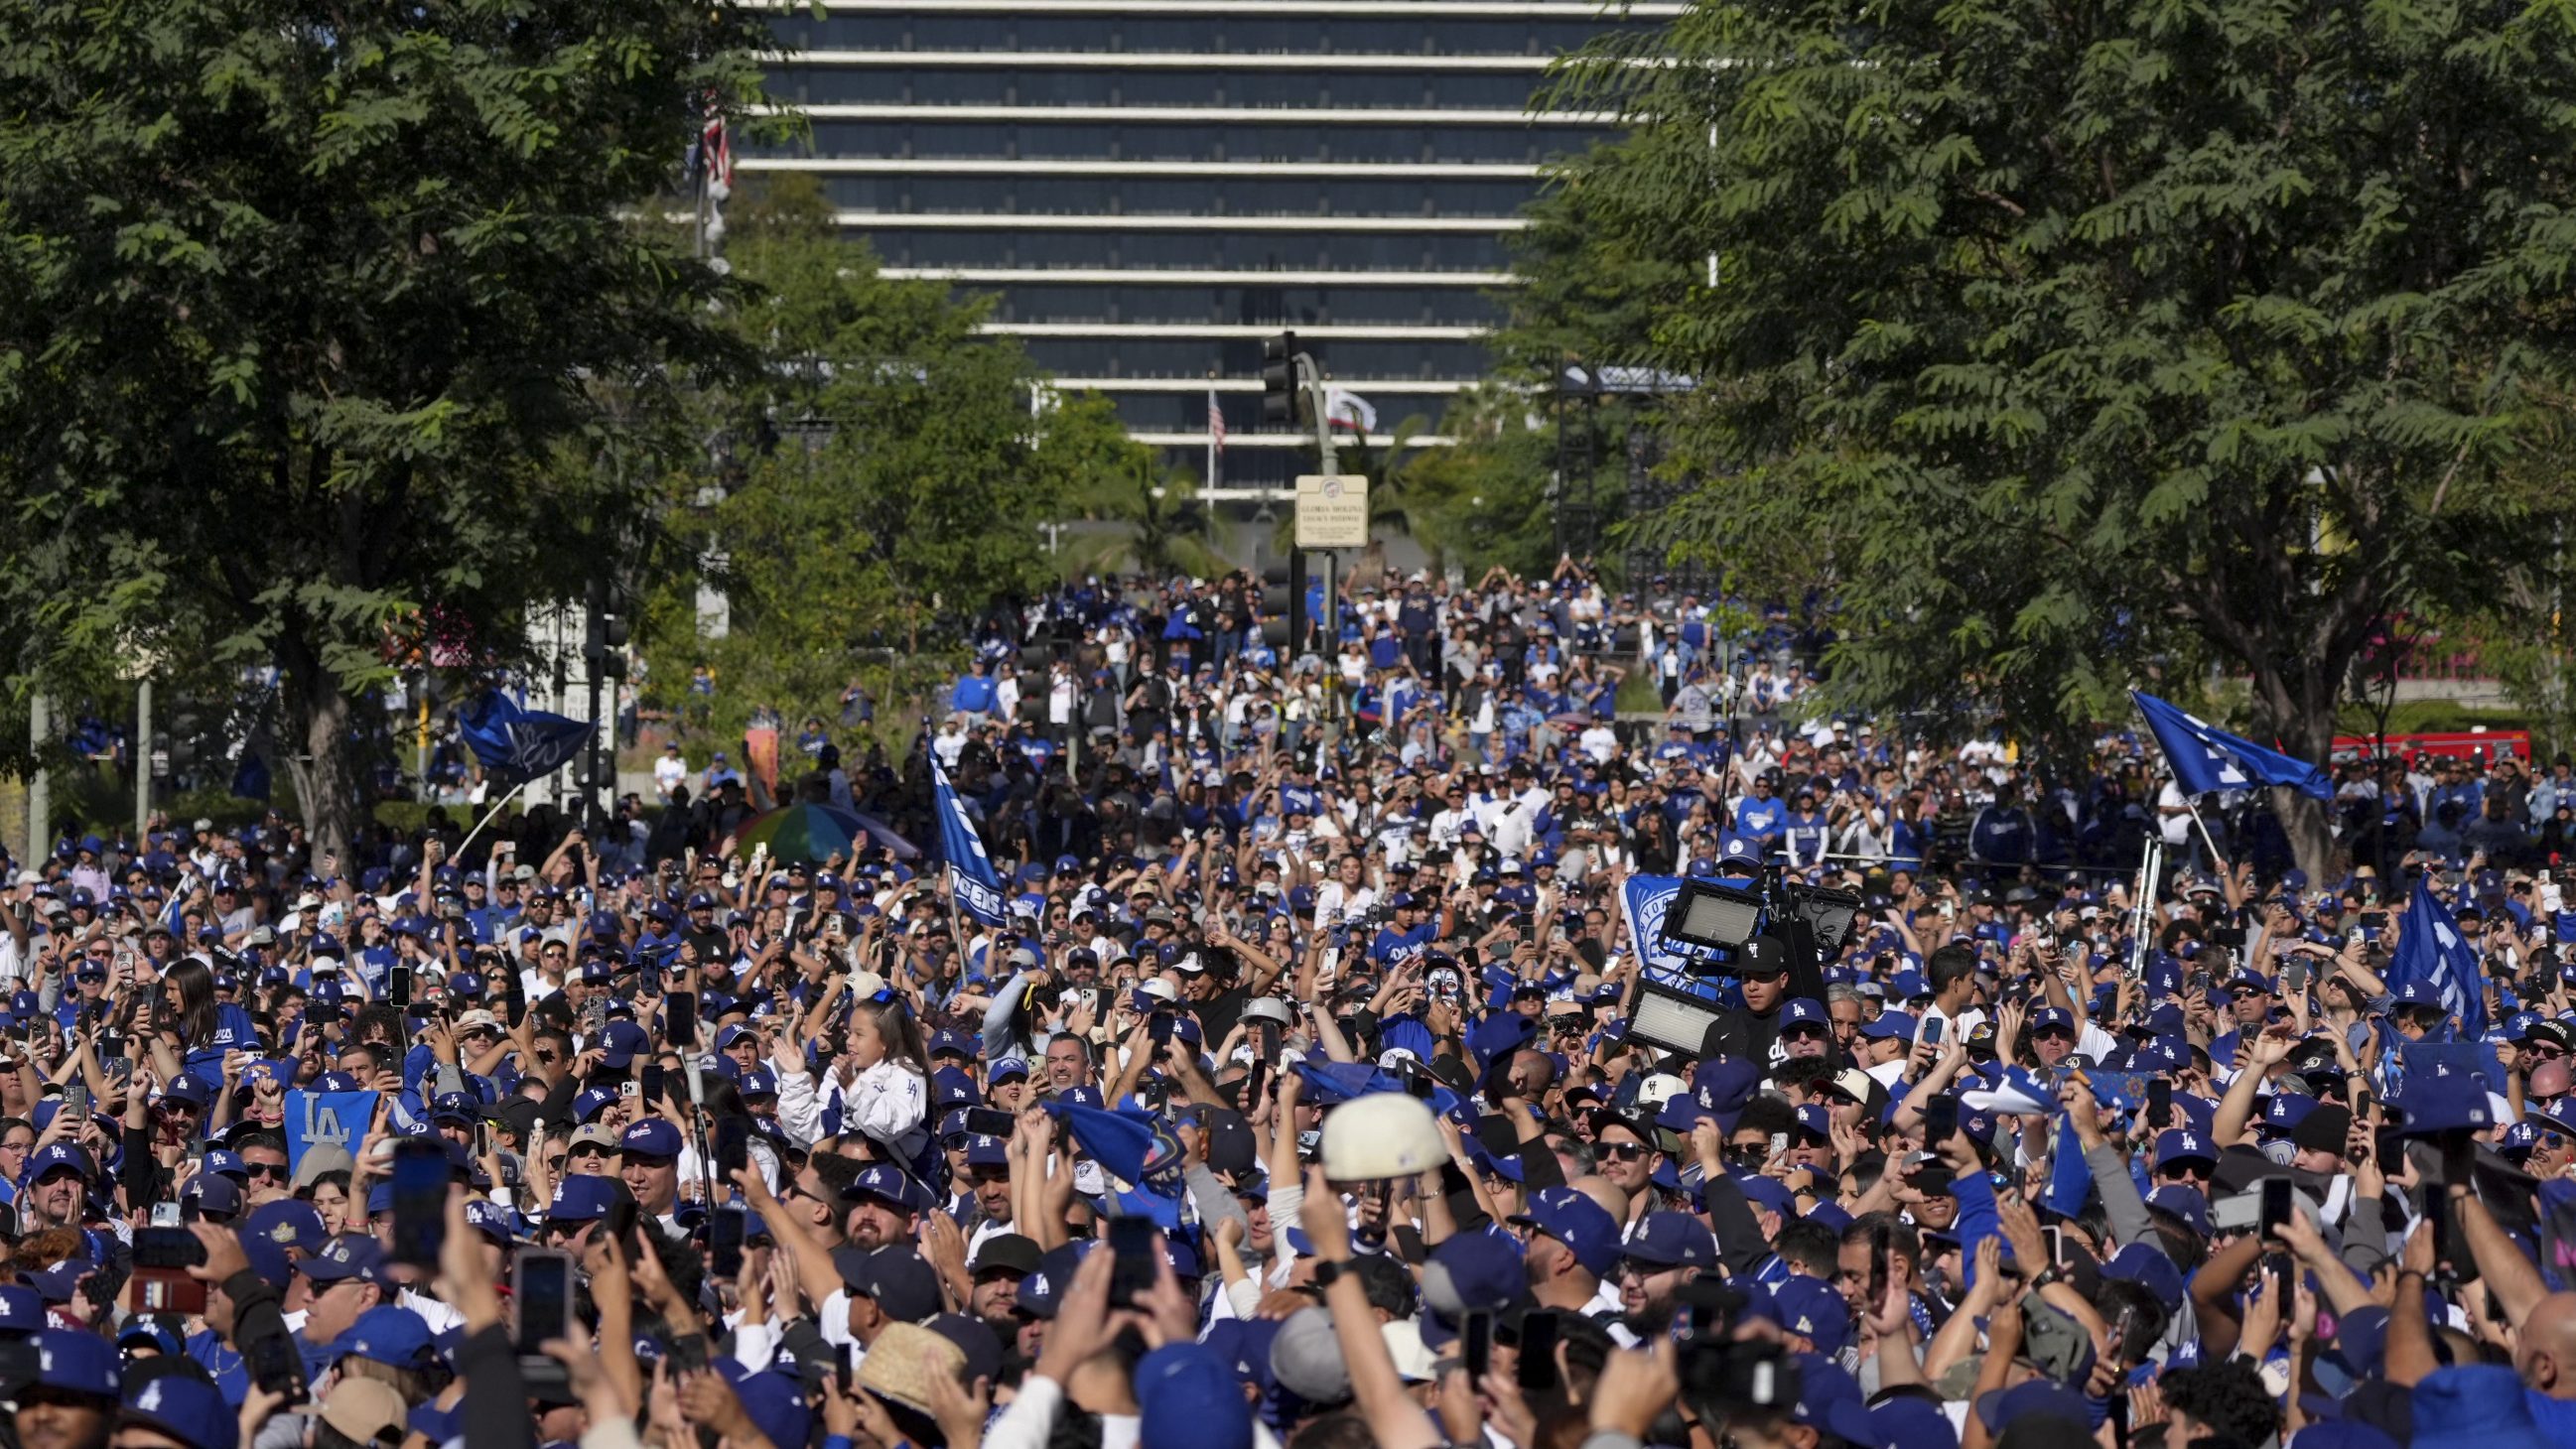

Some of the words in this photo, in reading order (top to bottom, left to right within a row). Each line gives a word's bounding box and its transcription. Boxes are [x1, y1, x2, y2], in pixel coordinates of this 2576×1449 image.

[2163, 974, 2172, 988] LA
[2405, 984, 2414, 997] LA
[1794, 1003, 1805, 1016] LA
[2048, 1008, 2058, 1020] LA
[1173, 1020, 1182, 1033] LA
[604, 1032, 612, 1047] LA
[942, 1031, 952, 1041] LA
[2165, 1036, 2174, 1049] LA
[2437, 1064, 2449, 1076] LA
[178, 1077, 188, 1089] LA
[328, 1077, 339, 1091] LA
[749, 1076, 761, 1090] LA
[907, 1079, 917, 1096] LA
[590, 1090, 606, 1102] LA
[954, 1089, 965, 1098] LA
[1074, 1089, 1085, 1102] LA
[1699, 1086, 1711, 1108] LA
[1798, 1108, 1809, 1120] LA
[2274, 1099, 2284, 1116] LA
[2549, 1099, 2563, 1116] LA
[301, 1092, 349, 1146] LA
[412, 1122, 427, 1134] D
[584, 1124, 594, 1134] LA
[629, 1127, 652, 1139] Dodgers
[2521, 1123, 2531, 1139] LA
[2182, 1132, 2197, 1149] LA
[52, 1145, 67, 1158] LA
[212, 1152, 227, 1165] LA
[868, 1168, 880, 1184] LA
[192, 1181, 203, 1197] LA
[467, 1205, 482, 1223] LA
[1035, 1273, 1049, 1294] LA
[47, 1311, 64, 1328] LA
